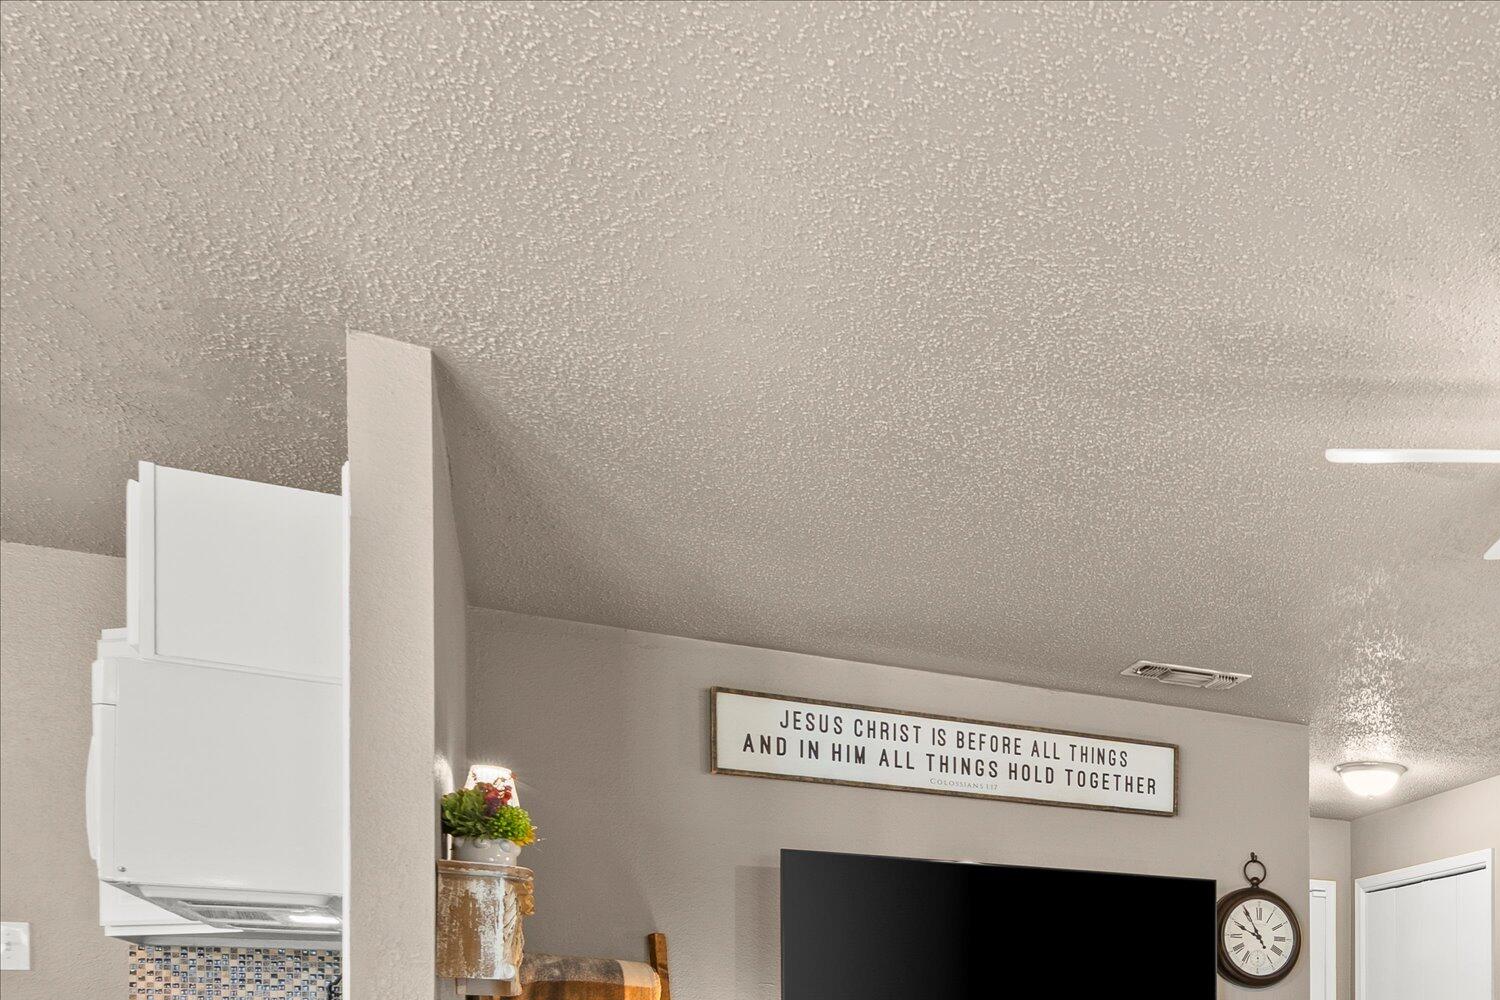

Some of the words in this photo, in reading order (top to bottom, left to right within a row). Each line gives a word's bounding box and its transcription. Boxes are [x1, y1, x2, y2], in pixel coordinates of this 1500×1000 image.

[742, 733, 788, 757] AND
[799, 738, 820, 760] IN
[830, 742, 866, 765] HIM
[878, 748, 916, 770] ALL
[925, 752, 999, 779] THINGS
[1007, 762, 1055, 785] HOLD
[1064, 768, 1157, 795] TOGETHER
[779, 709, 844, 736] JESUS
[853, 718, 922, 744] CHRIST
[931, 727, 947, 747] IS
[956, 730, 1022, 756] BEFORE
[1030, 739, 1061, 760] ALL
[1068, 743, 1129, 768] THINGS
